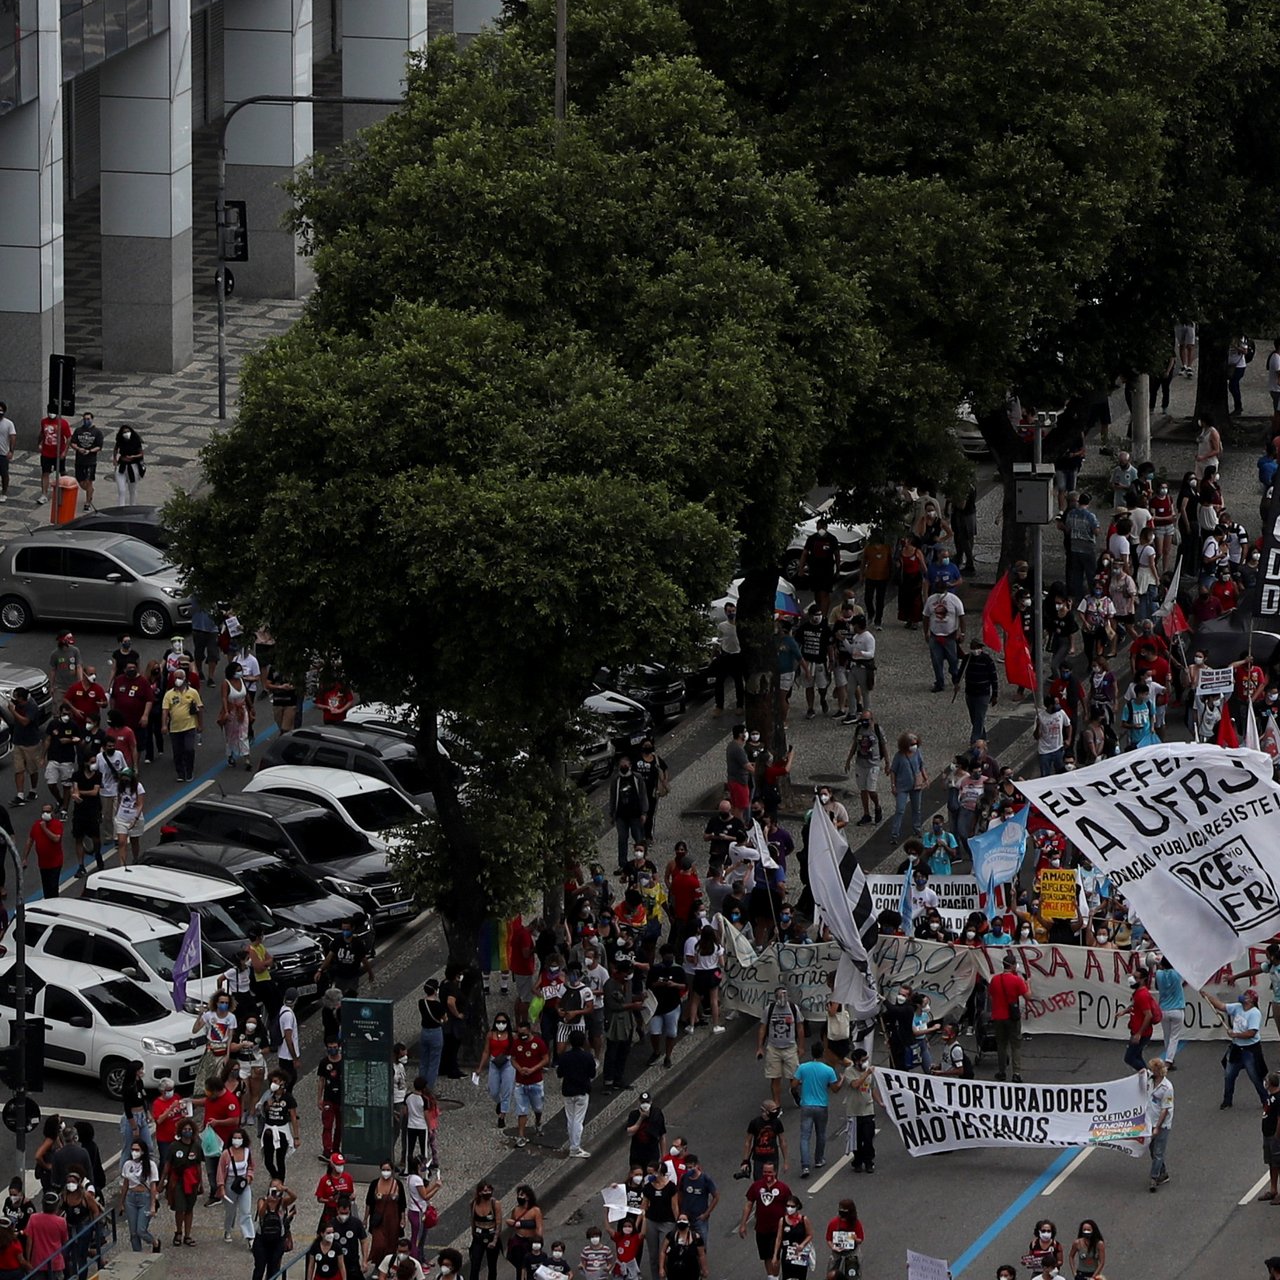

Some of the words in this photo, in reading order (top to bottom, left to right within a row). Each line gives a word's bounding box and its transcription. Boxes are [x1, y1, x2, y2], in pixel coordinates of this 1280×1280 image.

[1039, 786, 1088, 818] EU
[1075, 814, 1128, 862] A
[1114, 758, 1260, 838] UFRJ
[1152, 823, 1211, 861] PÚBLICA
[950, 881, 979, 896] DÍVIDA
[1083, 949, 1105, 983] A
[1024, 990, 1078, 1020] ADUFRJ
[889, 1092, 909, 1121] E
[942, 1081, 1109, 1113] TORTURADORES
[1092, 1109, 1132, 1123] COLETIVO
[1132, 1105, 1143, 1117] RJ
[899, 1116, 947, 1150] NÃO
